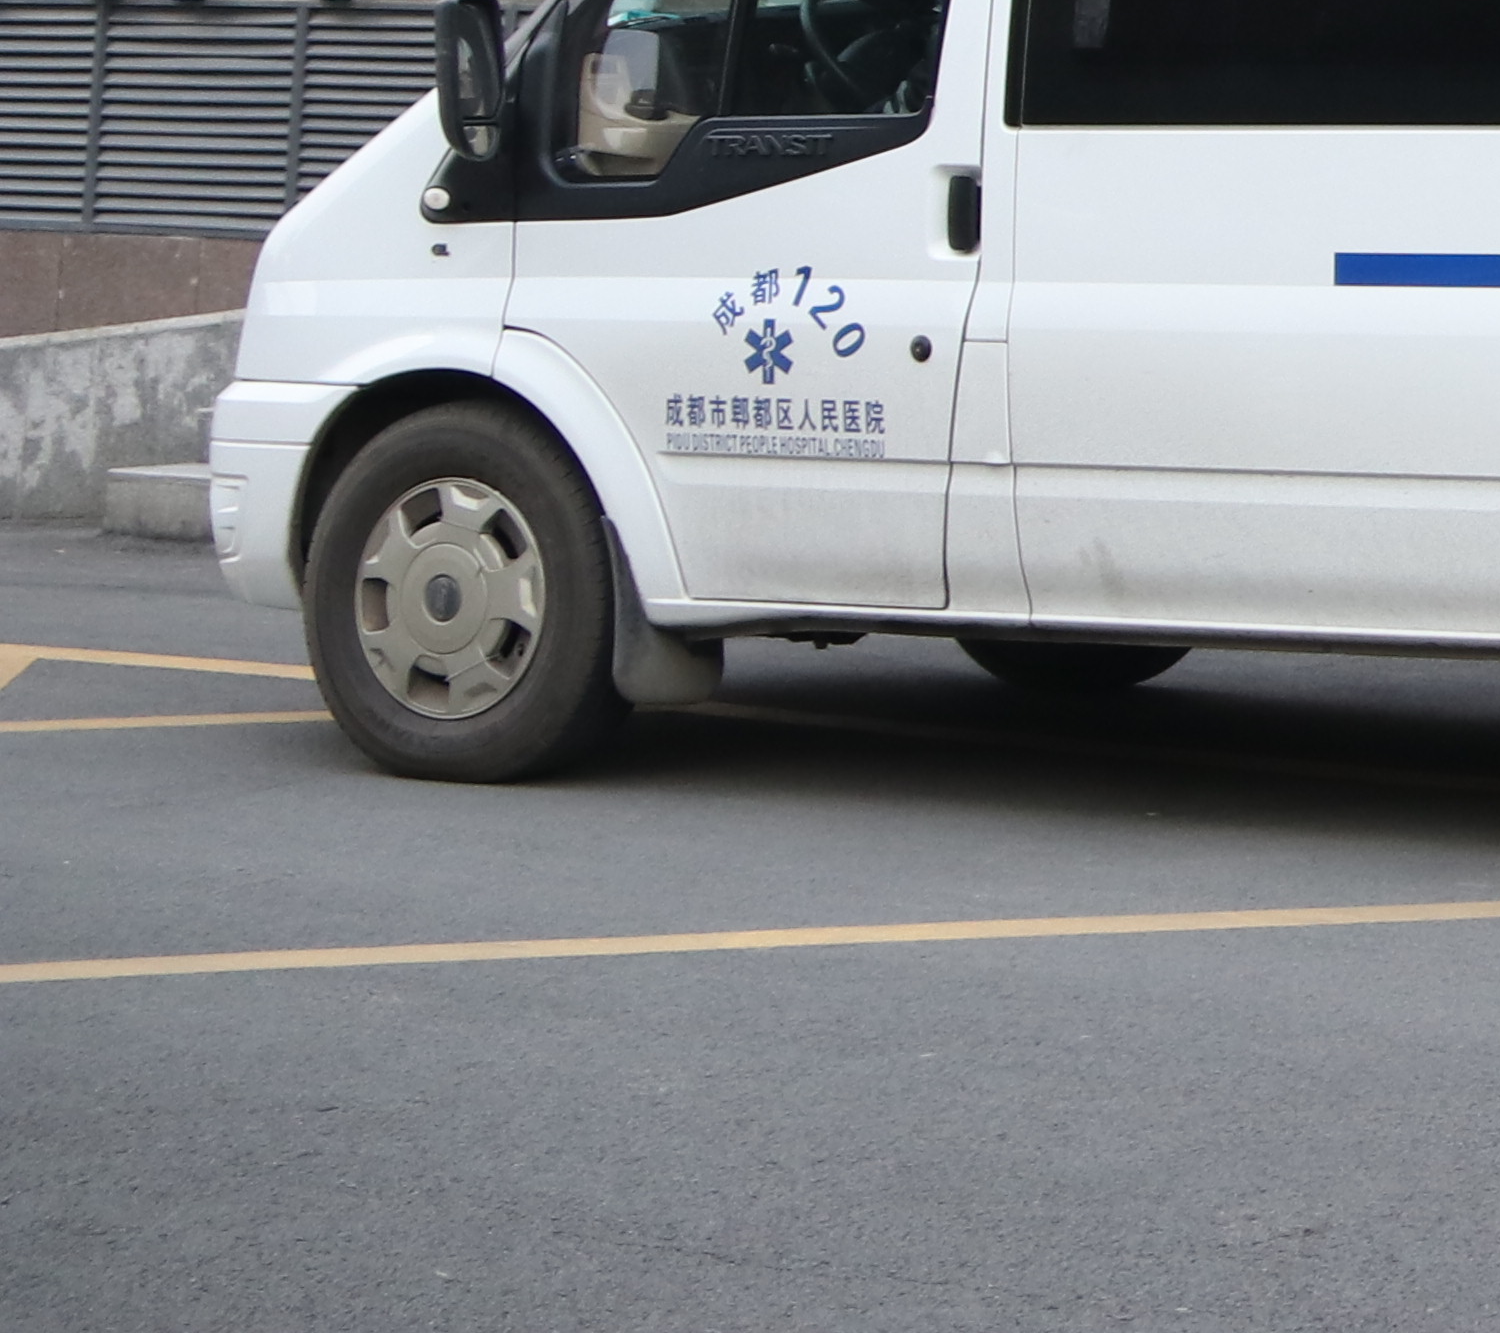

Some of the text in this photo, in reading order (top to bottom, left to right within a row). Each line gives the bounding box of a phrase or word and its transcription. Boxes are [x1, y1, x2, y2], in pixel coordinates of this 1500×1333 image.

[706, 134, 833, 156] TRANSIT
[665, 394, 886, 434] 成都市郫都区人民医院
[692, 434, 737, 453] DISTRICT
[740, 435, 777, 454] PEOPLE
